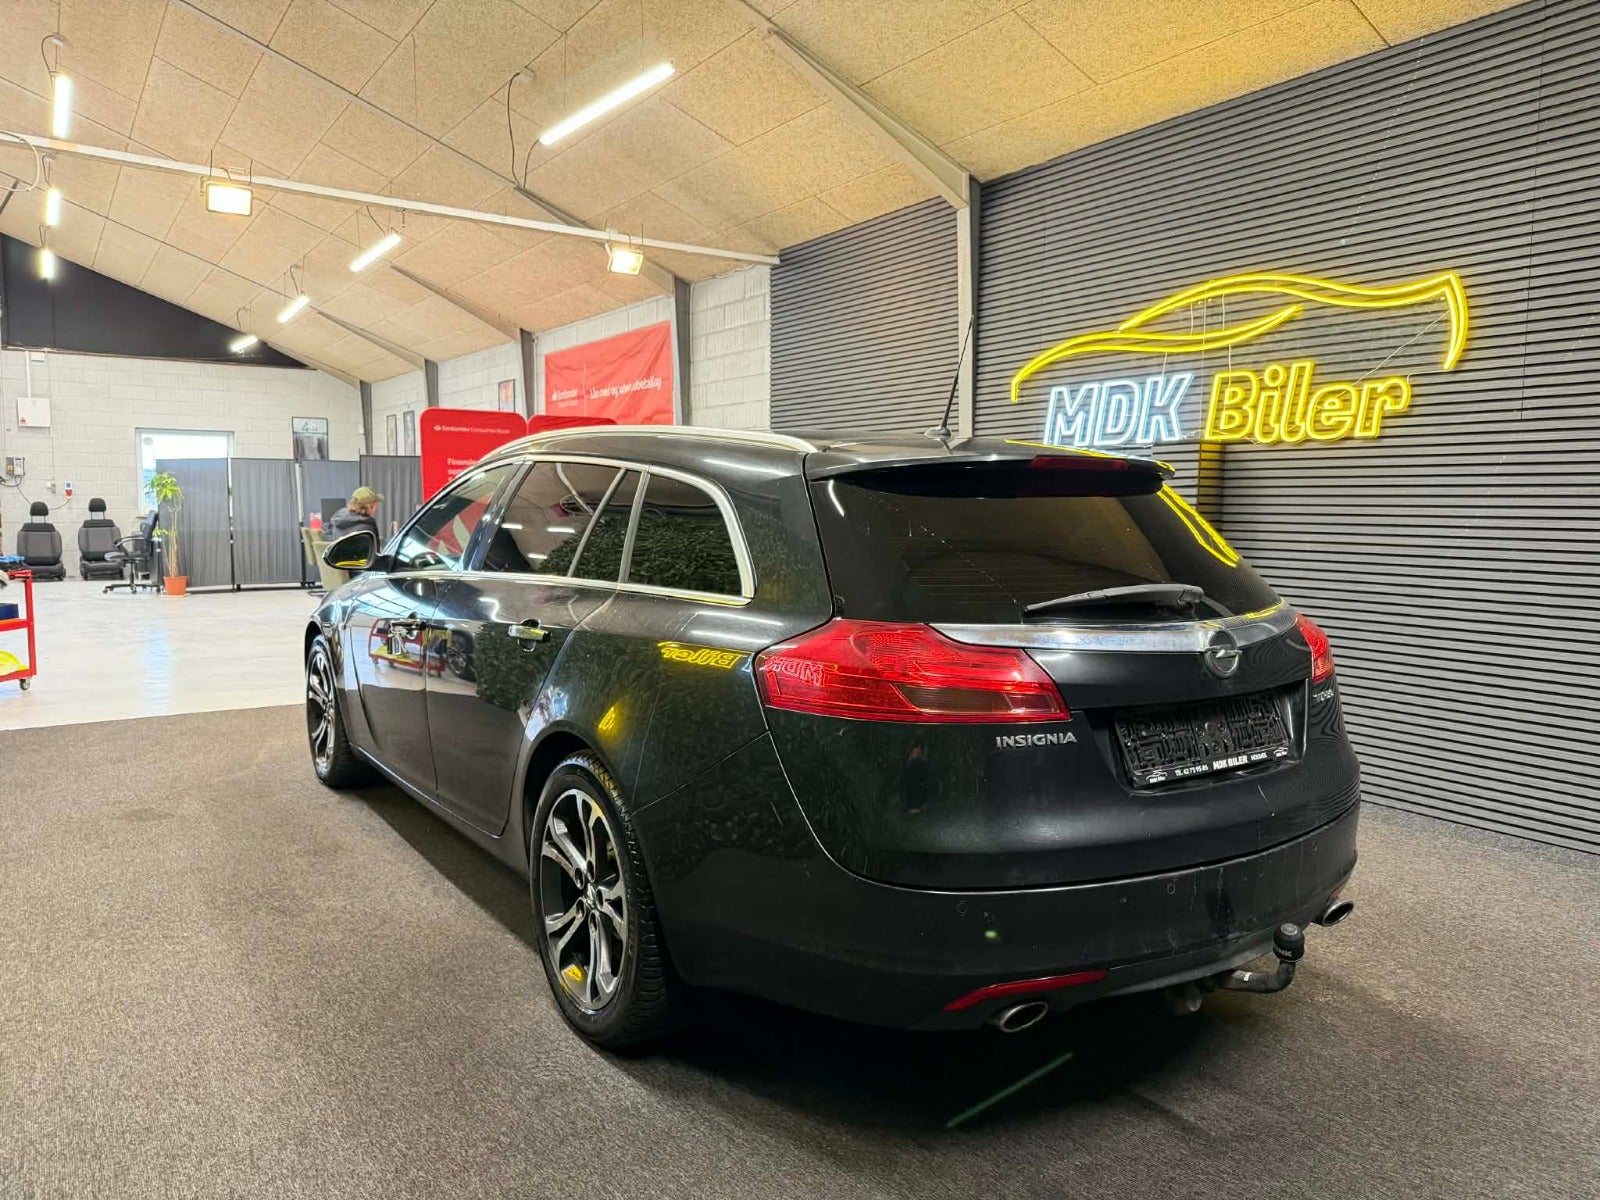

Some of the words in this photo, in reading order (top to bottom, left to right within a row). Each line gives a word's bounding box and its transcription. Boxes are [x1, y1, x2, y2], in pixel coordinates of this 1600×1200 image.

[1042, 372, 1195, 448] MDK
[1204, 361, 1411, 443] Biler
[995, 732, 1077, 749] INSIGNIA
[1228, 755, 1248, 767] BILER
